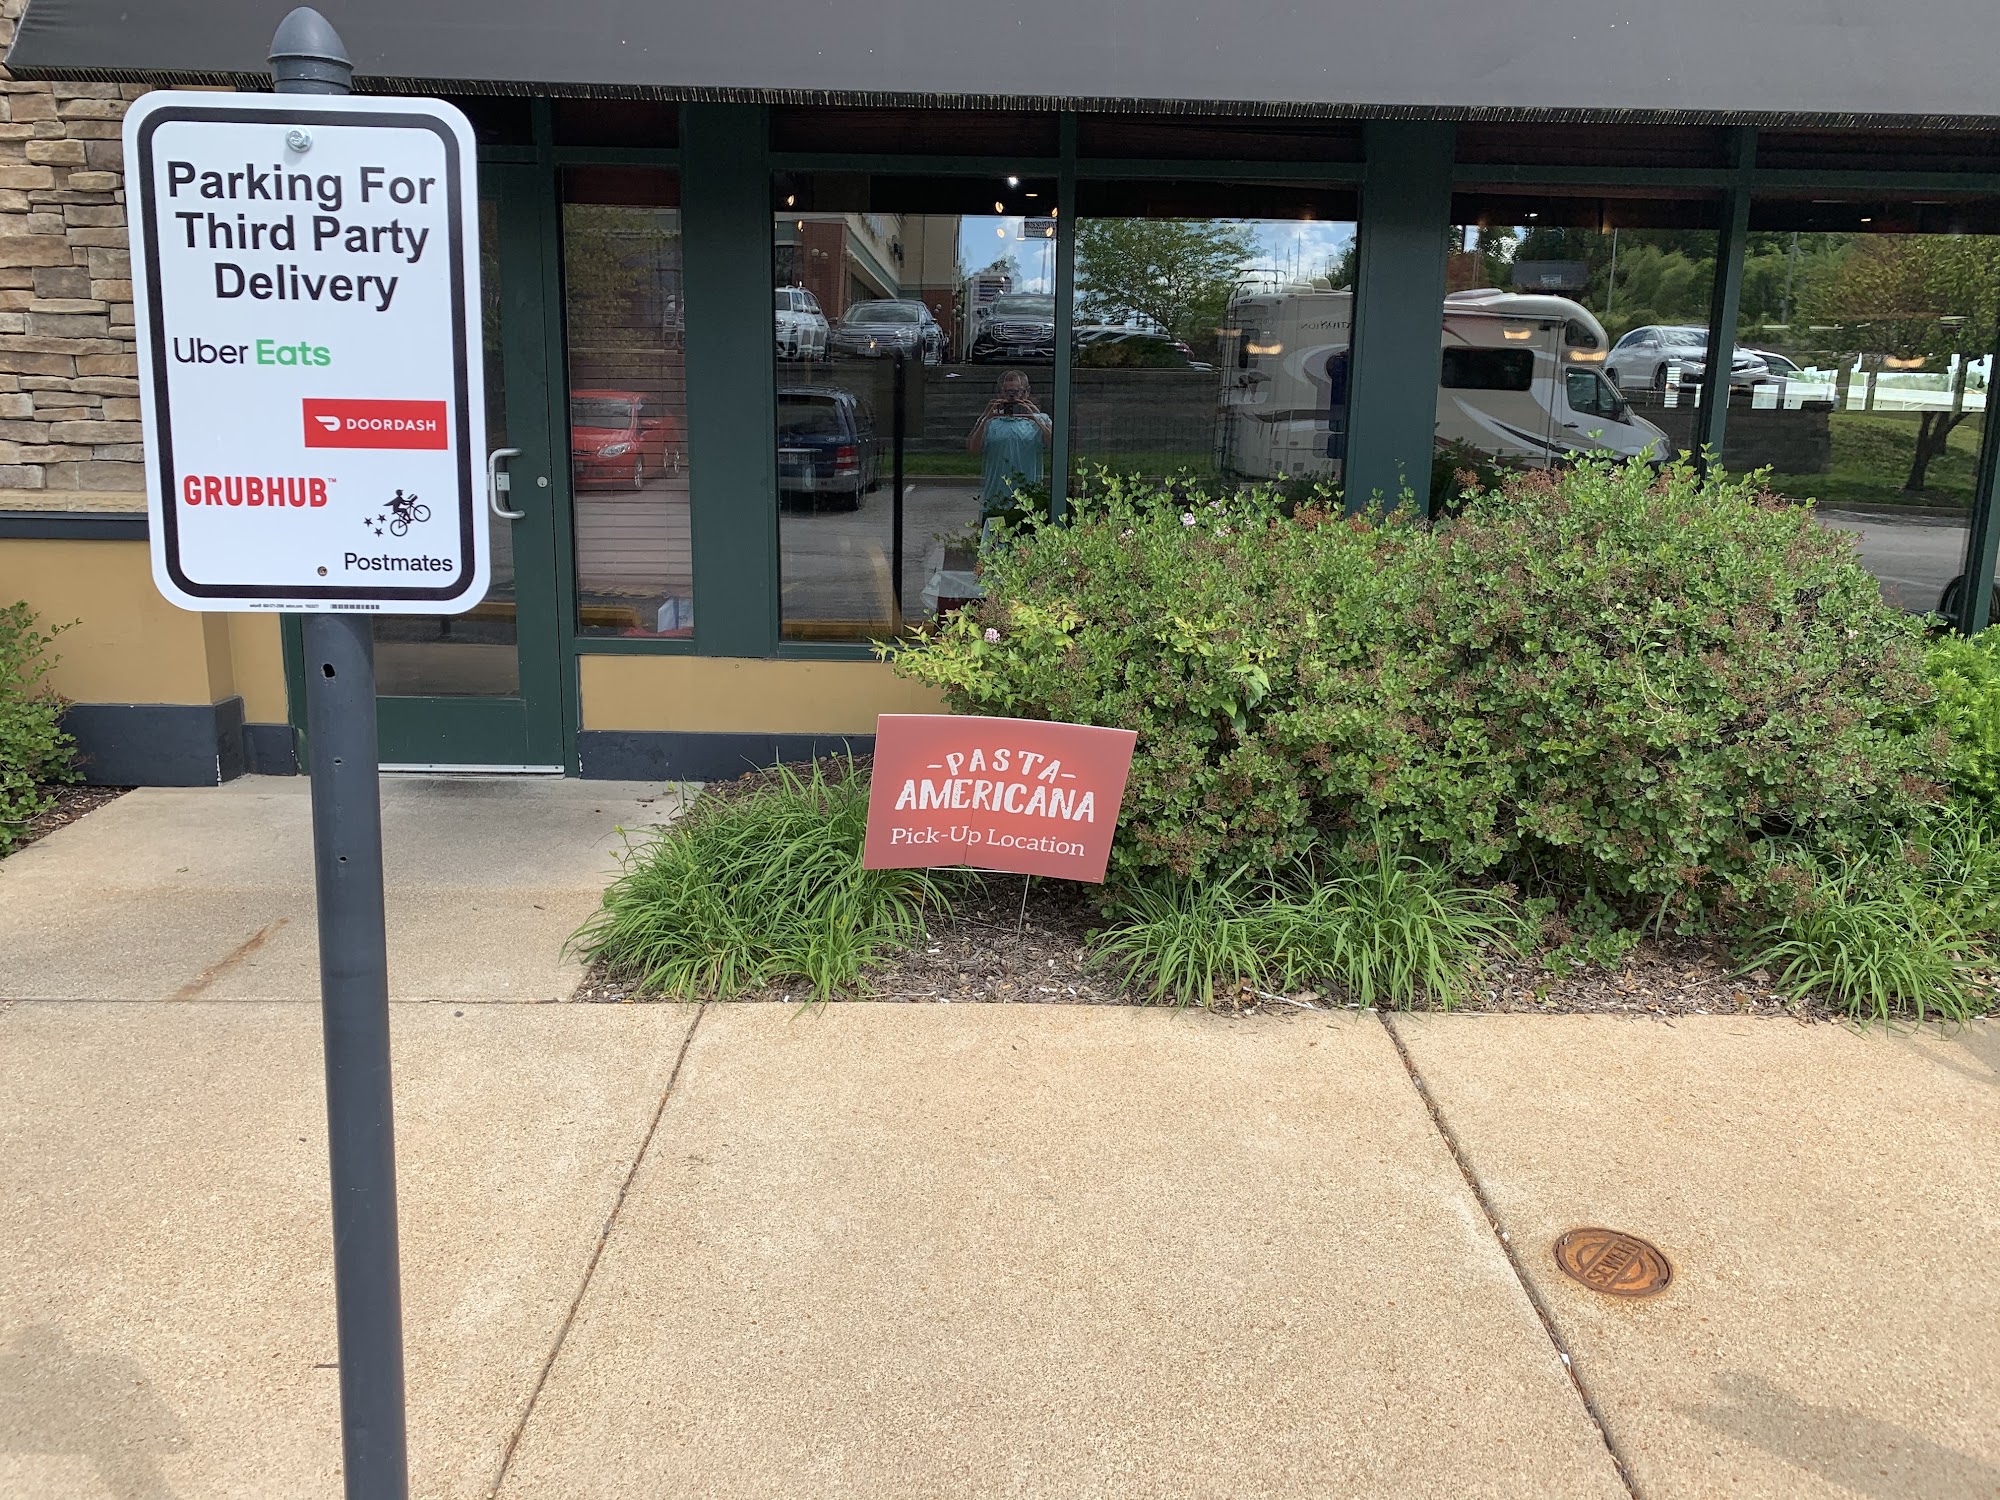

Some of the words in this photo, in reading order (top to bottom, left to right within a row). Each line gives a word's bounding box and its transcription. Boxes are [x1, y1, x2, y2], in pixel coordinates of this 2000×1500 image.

[167, 161, 342, 211] Parking
[360, 167, 435, 204] For
[175, 212, 295, 251] Third
[313, 215, 429, 263] Party
[215, 262, 399, 312] Delivery
[173, 337, 249, 365] Uber
[256, 339, 331, 366] Eats
[346, 418, 436, 431] DOORDASH
[183, 475, 328, 507] GRUBHUB
[344, 552, 453, 572] Postmates
[895, 779, 1095, 823] AMERICANA
[890, 826, 982, 846] Pick-Up
[986, 828, 1085, 857] Location
[1586, 1241, 1641, 1284] SEWER
